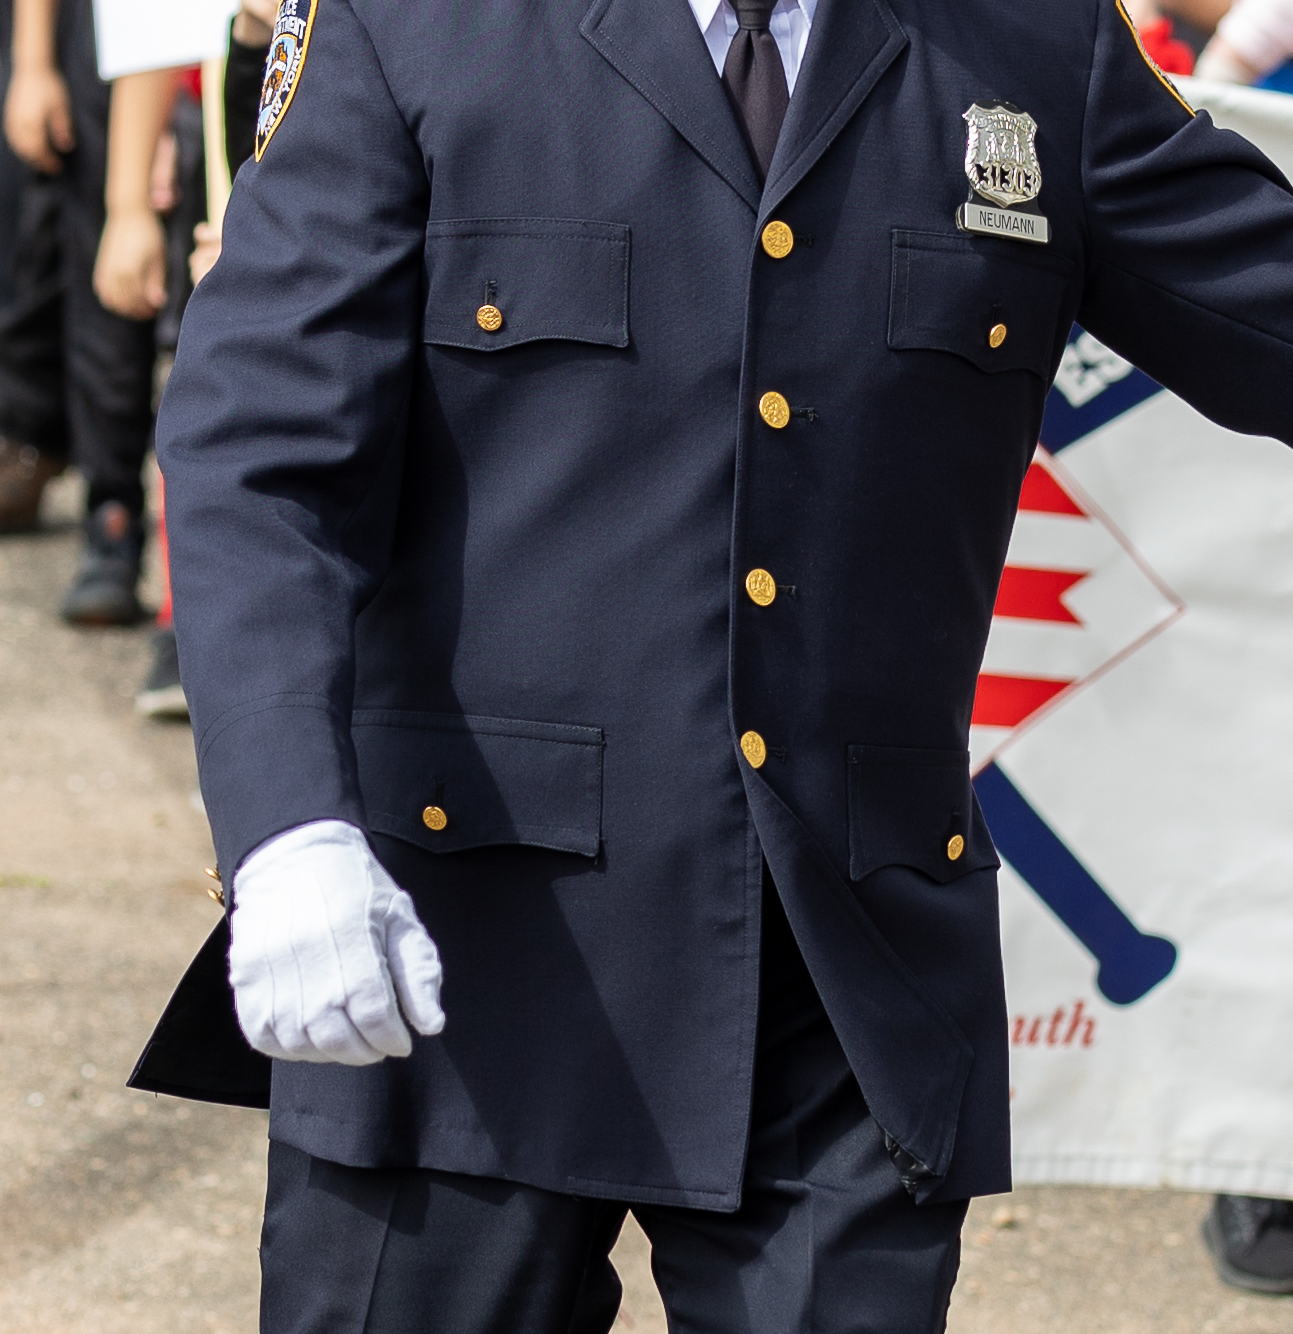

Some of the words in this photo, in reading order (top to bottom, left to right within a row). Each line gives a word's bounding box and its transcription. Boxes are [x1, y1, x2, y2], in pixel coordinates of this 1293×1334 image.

[980, 162, 1037, 196] 31303
[979, 210, 1035, 235] NEUMANN
[1011, 998, 1096, 1047] uth
